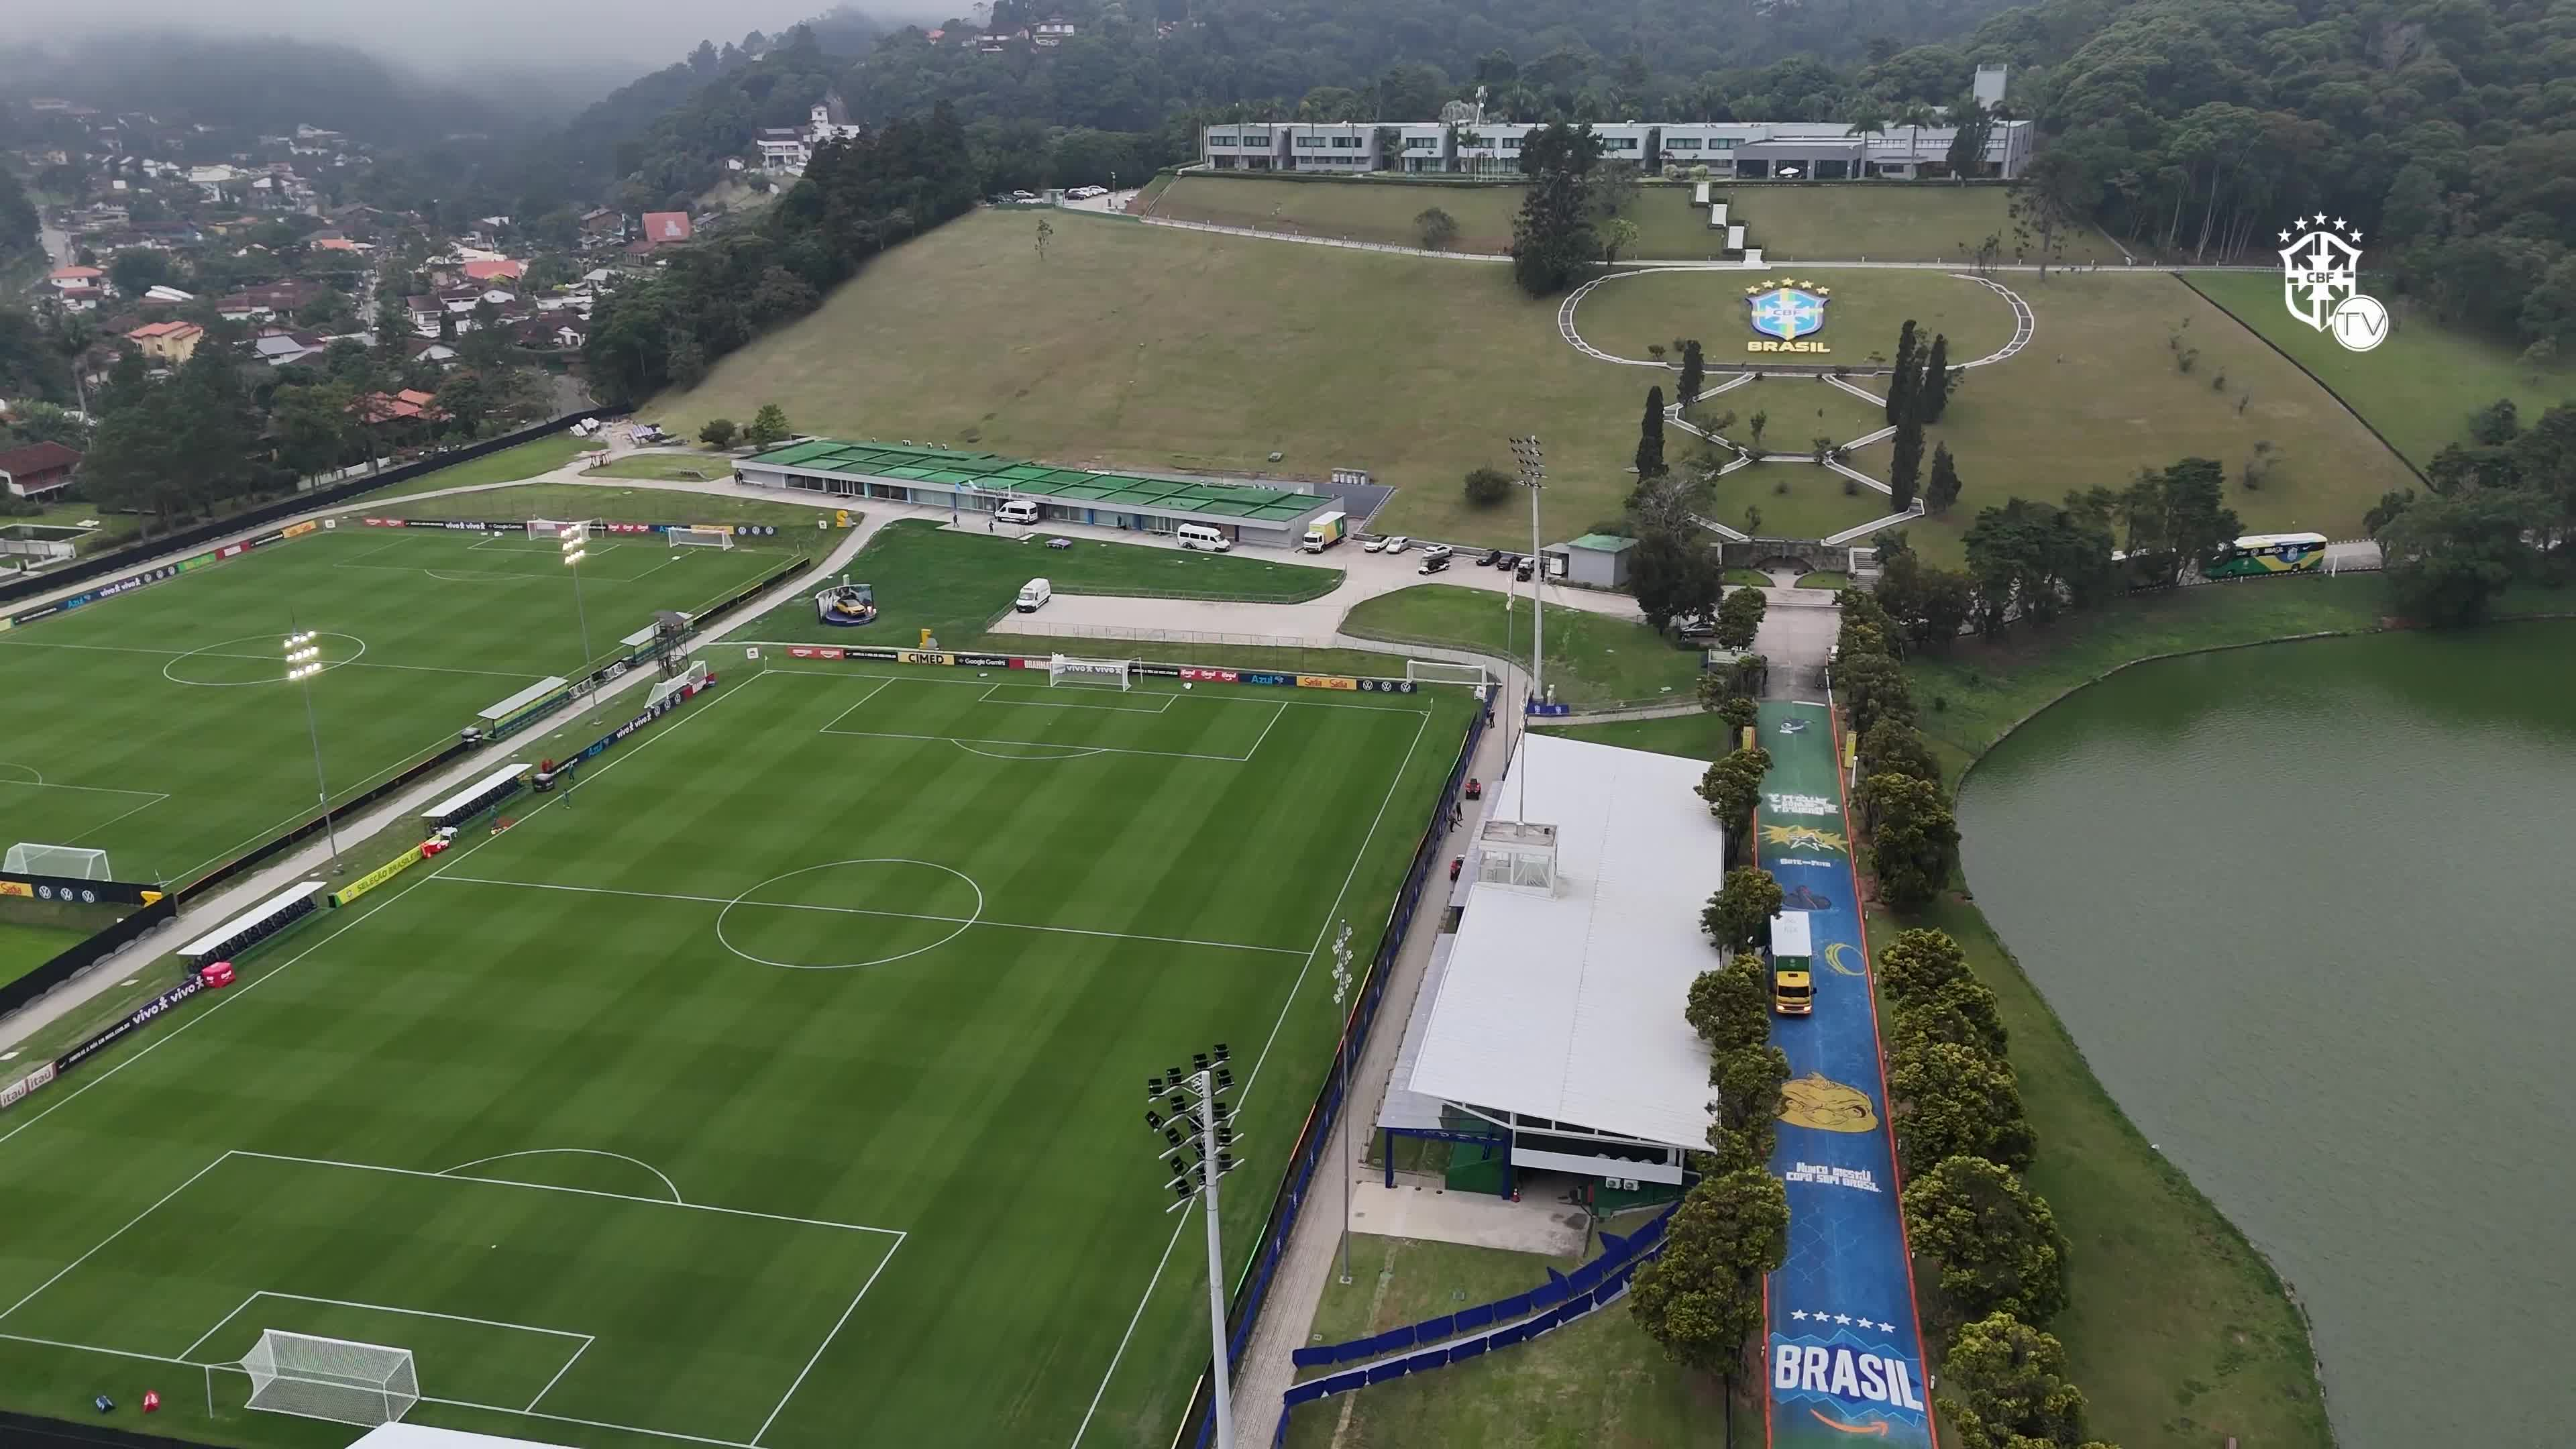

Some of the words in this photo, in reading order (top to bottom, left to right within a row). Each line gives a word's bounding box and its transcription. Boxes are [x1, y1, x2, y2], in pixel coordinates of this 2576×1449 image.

[1747, 341, 1831, 353] BRASIL
[908, 653, 945, 664] CIMED
[965, 658, 985, 666] Google
[1250, 674, 1273, 684] Azul
[616, 727, 629, 739] vivo
[635, 716, 647, 728] vivo
[132, 1006, 159, 1024] vivo
[170, 984, 195, 1002] vivo
[1774, 1344, 1925, 1412] BRASIL
